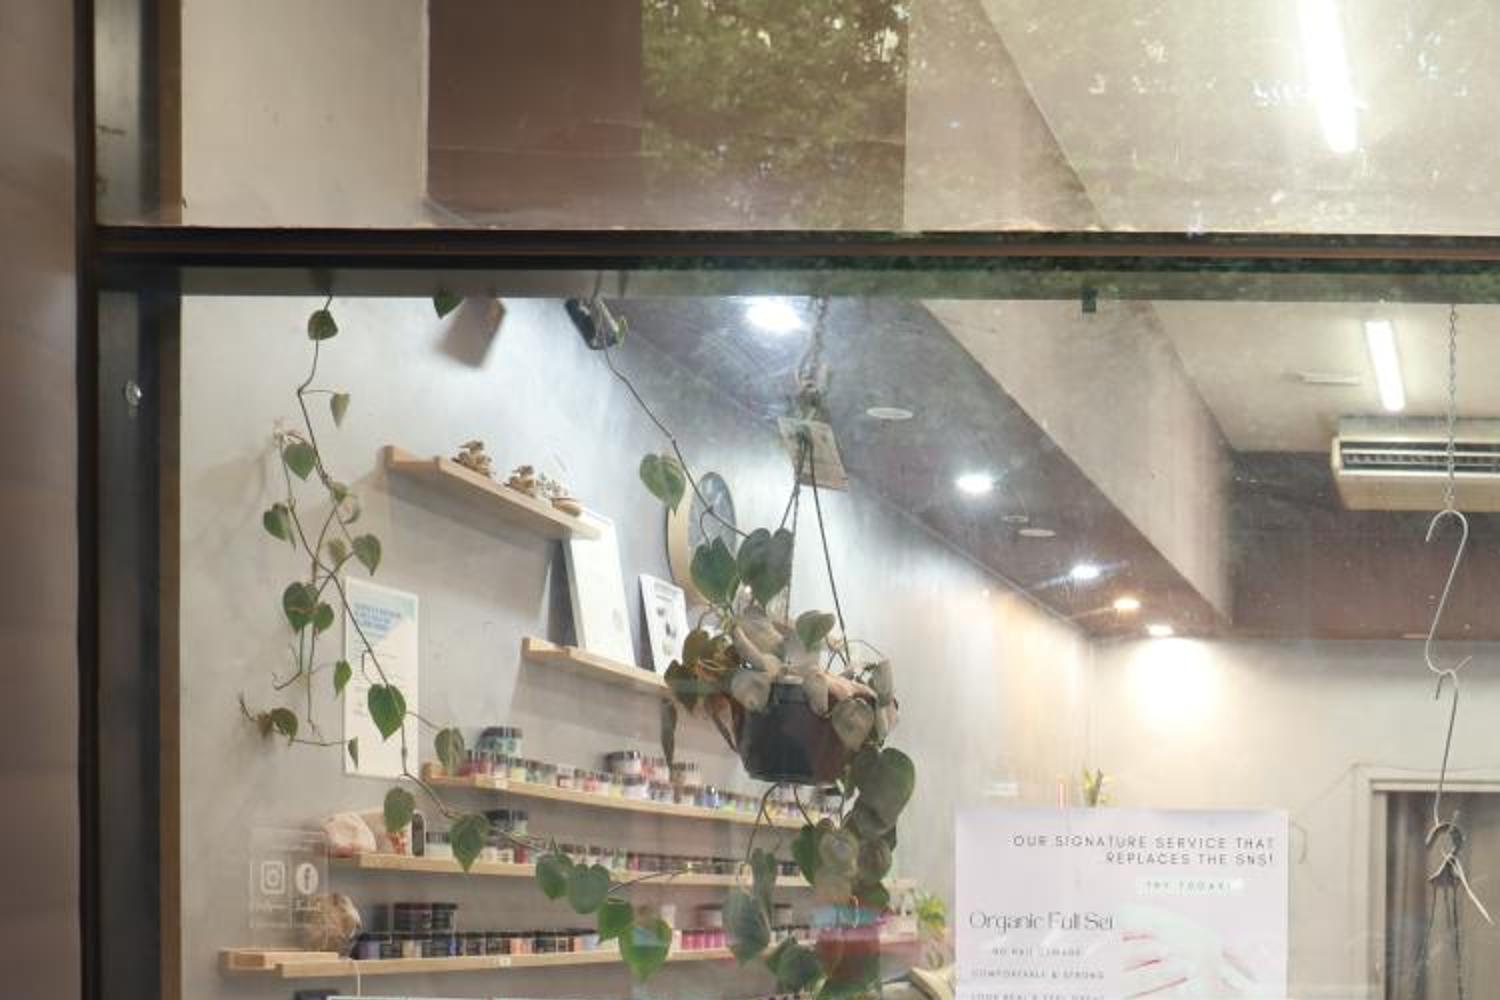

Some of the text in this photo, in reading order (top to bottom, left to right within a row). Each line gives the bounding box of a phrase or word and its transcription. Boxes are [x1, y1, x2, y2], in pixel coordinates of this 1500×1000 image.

[1013, 834, 1276, 850] OUR SIGNATURE SERVICE THAT
[1105, 851, 1191, 866] REPLACES
[1199, 852, 1227, 866] THE
[969, 910, 1040, 936] Organic
[1047, 910, 1082, 931] Full
